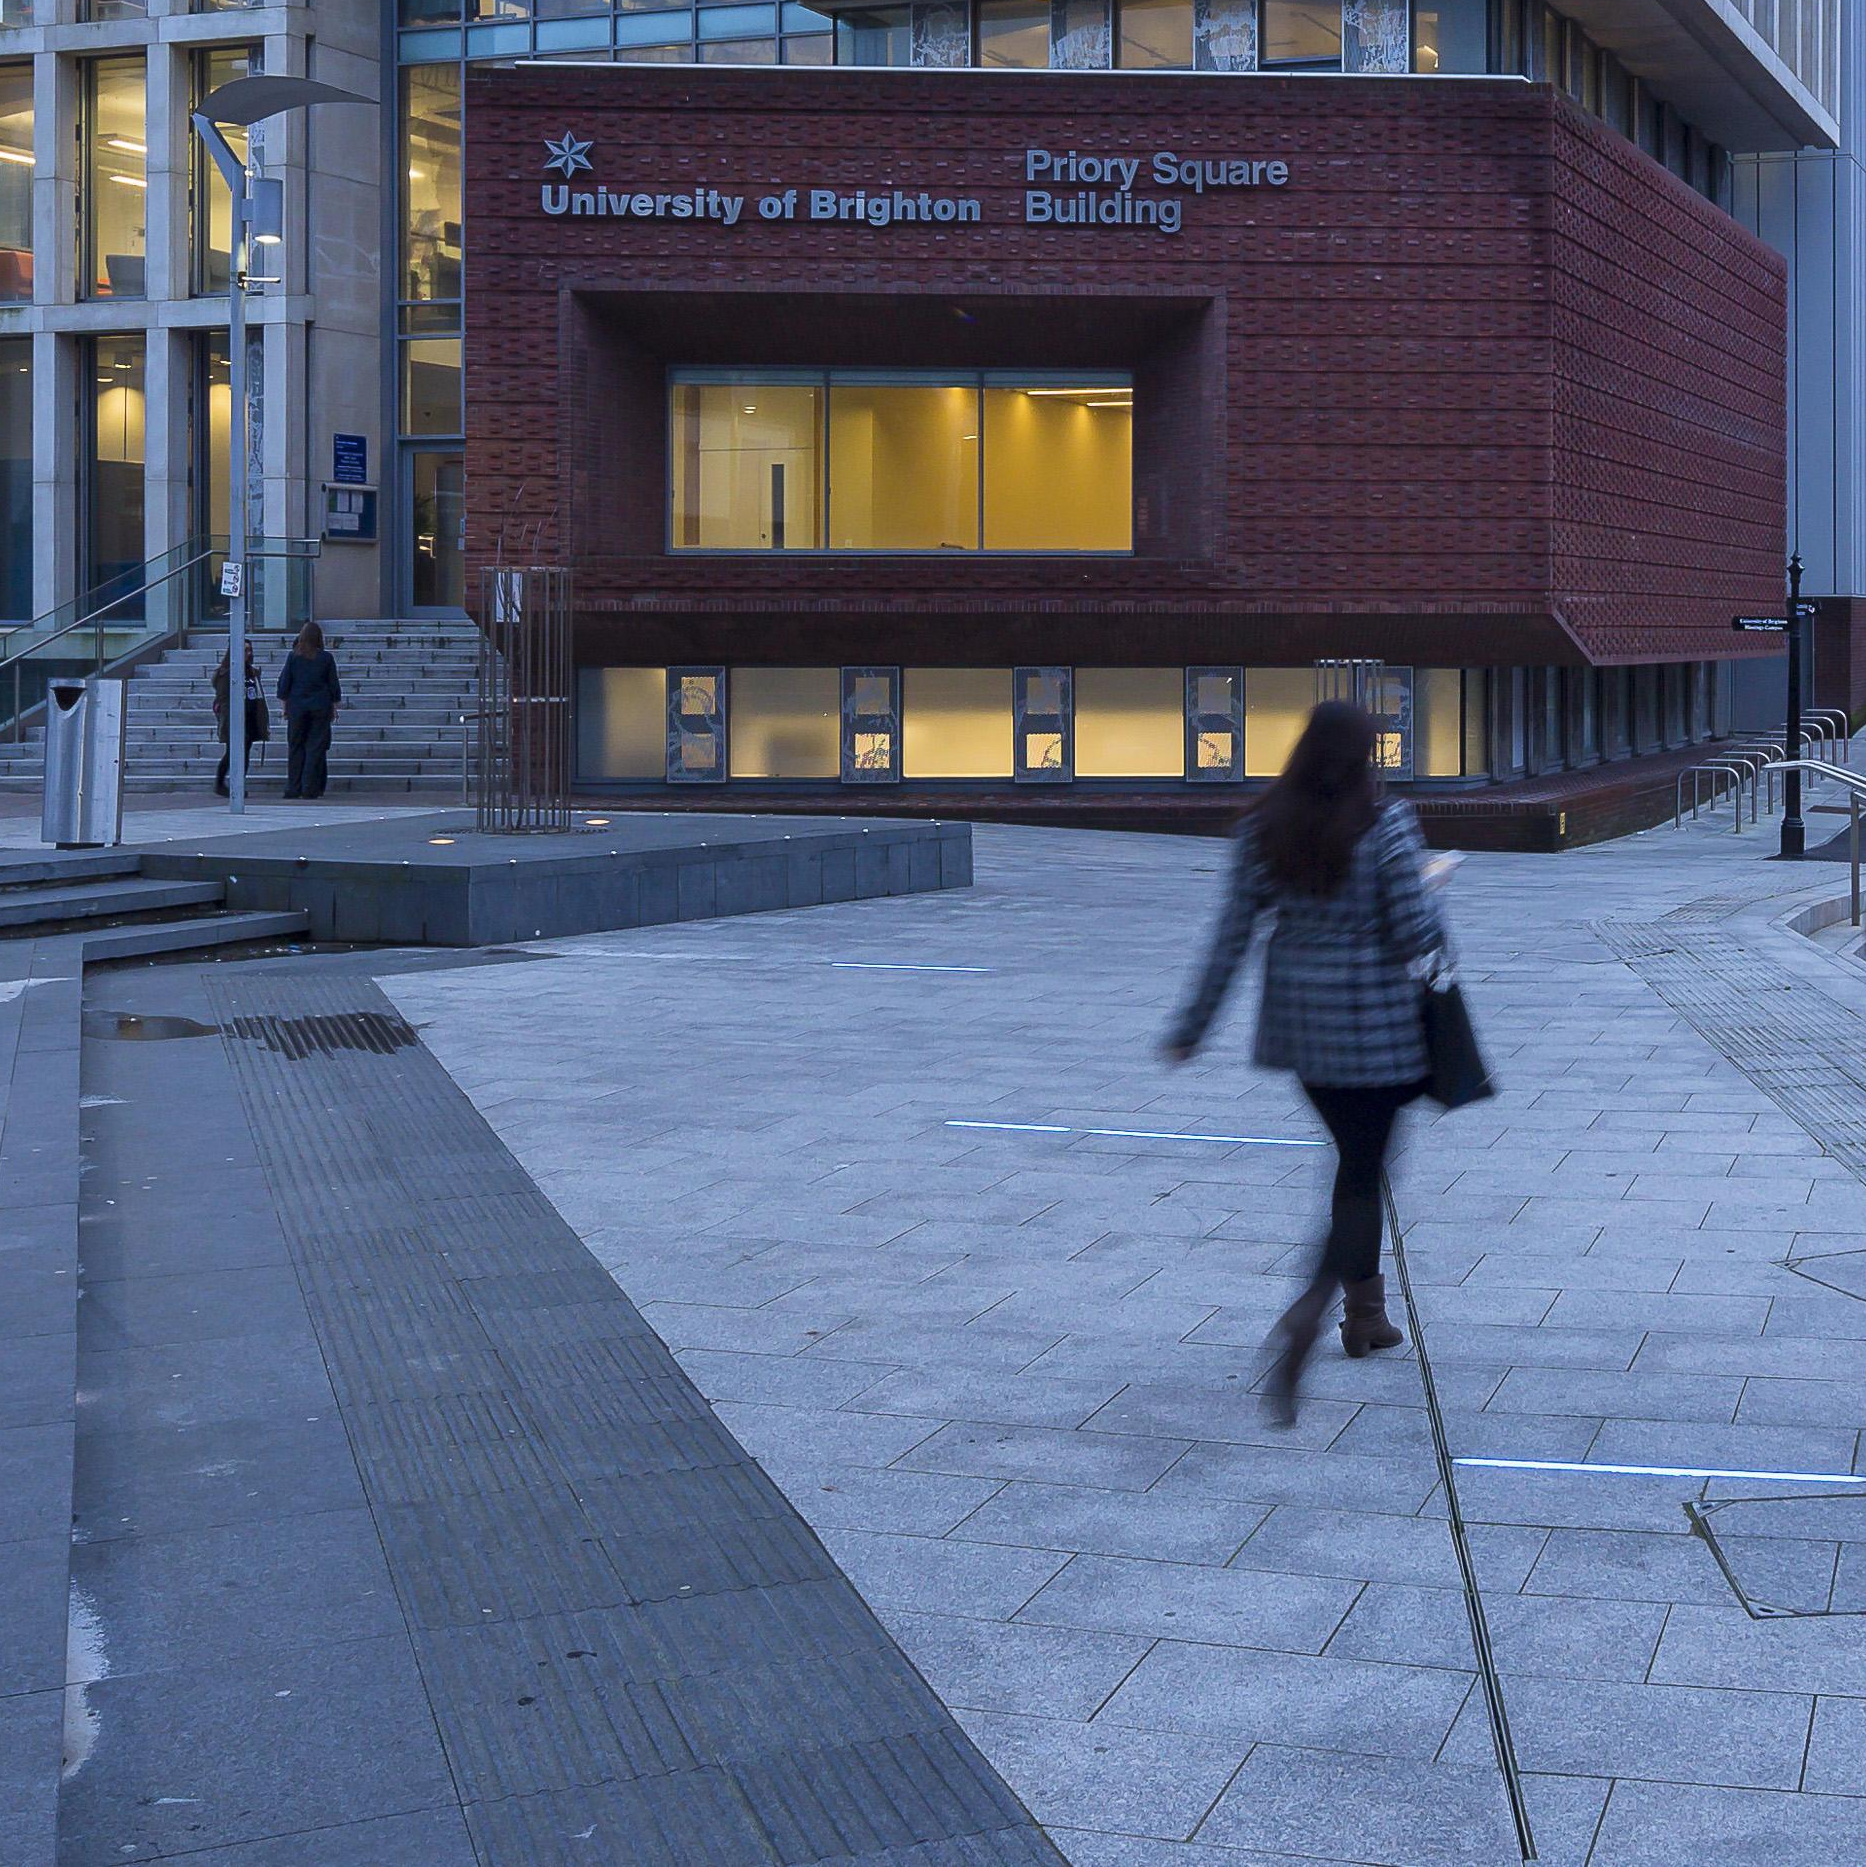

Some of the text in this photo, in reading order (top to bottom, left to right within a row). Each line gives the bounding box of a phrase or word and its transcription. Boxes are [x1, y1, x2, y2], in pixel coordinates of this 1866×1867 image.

[1026, 149, 1289, 193] Priory Square
[541, 184, 981, 226] University of Brighton
[1026, 190, 1182, 233] Building
